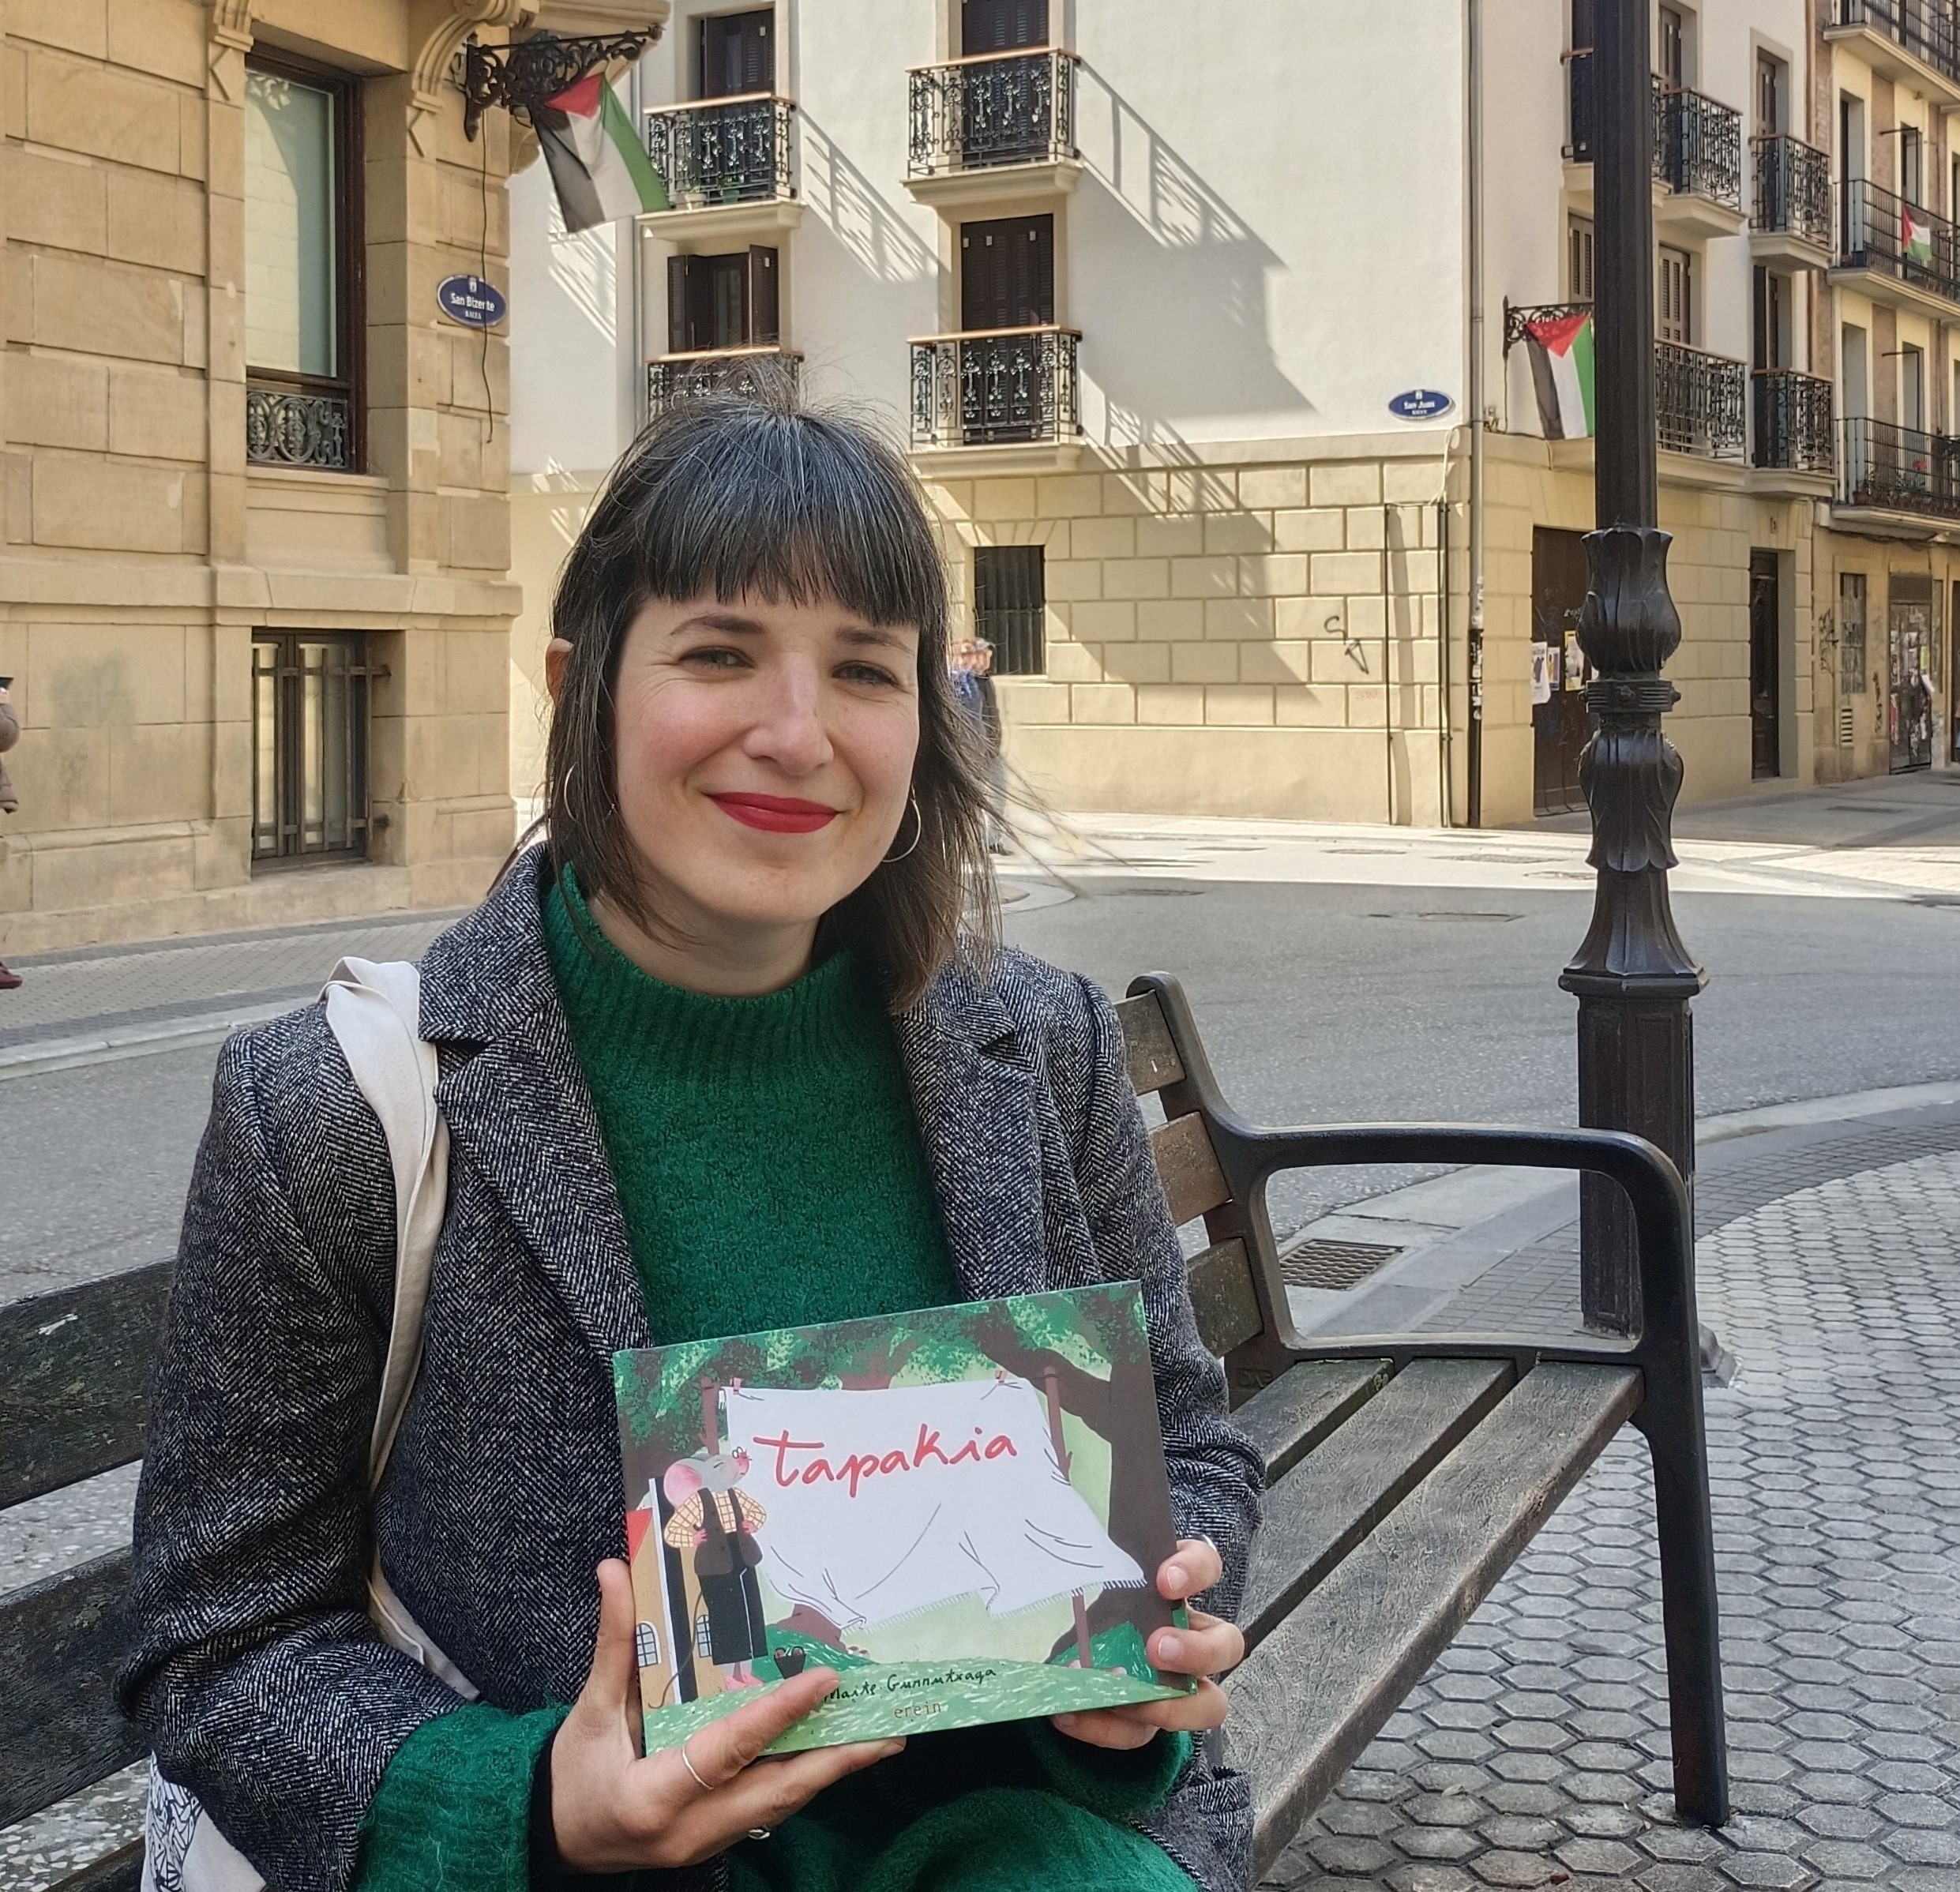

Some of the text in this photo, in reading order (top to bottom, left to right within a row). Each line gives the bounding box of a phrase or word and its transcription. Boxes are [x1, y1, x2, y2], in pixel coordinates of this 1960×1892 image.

[450, 292, 465, 306] San
[753, 1423, 1018, 1498] tapakia
[894, 1701, 941, 1719] erein
